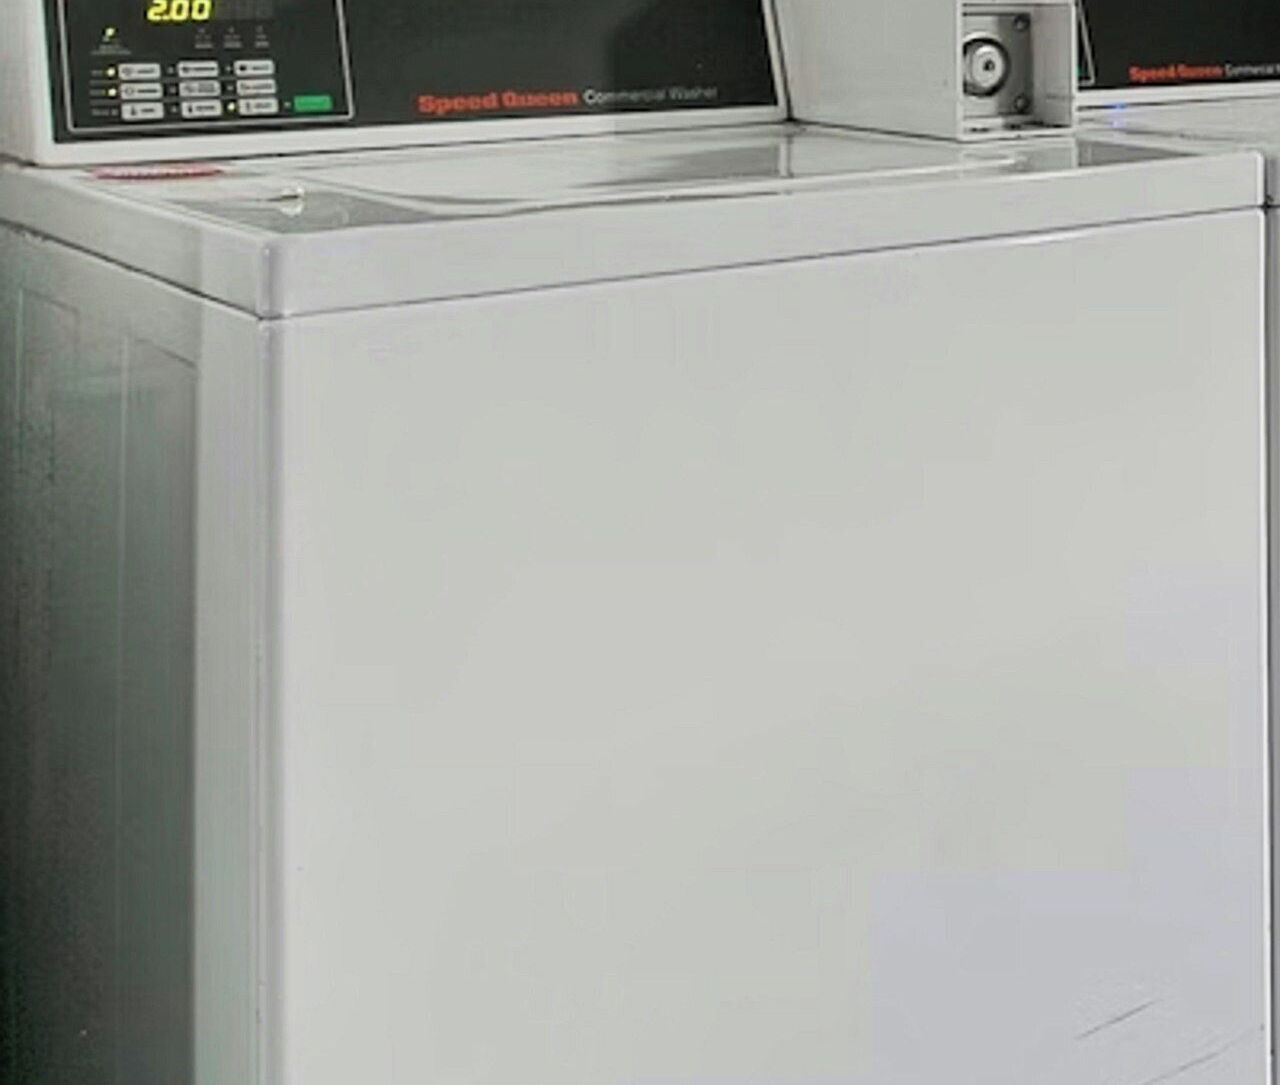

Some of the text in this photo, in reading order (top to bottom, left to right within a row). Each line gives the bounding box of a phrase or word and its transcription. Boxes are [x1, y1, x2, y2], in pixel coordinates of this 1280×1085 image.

[1128, 66, 1175, 83] Speed
[1177, 64, 1222, 80] Queen
[418, 85, 718, 114] Speed Queen Commercial Washer
